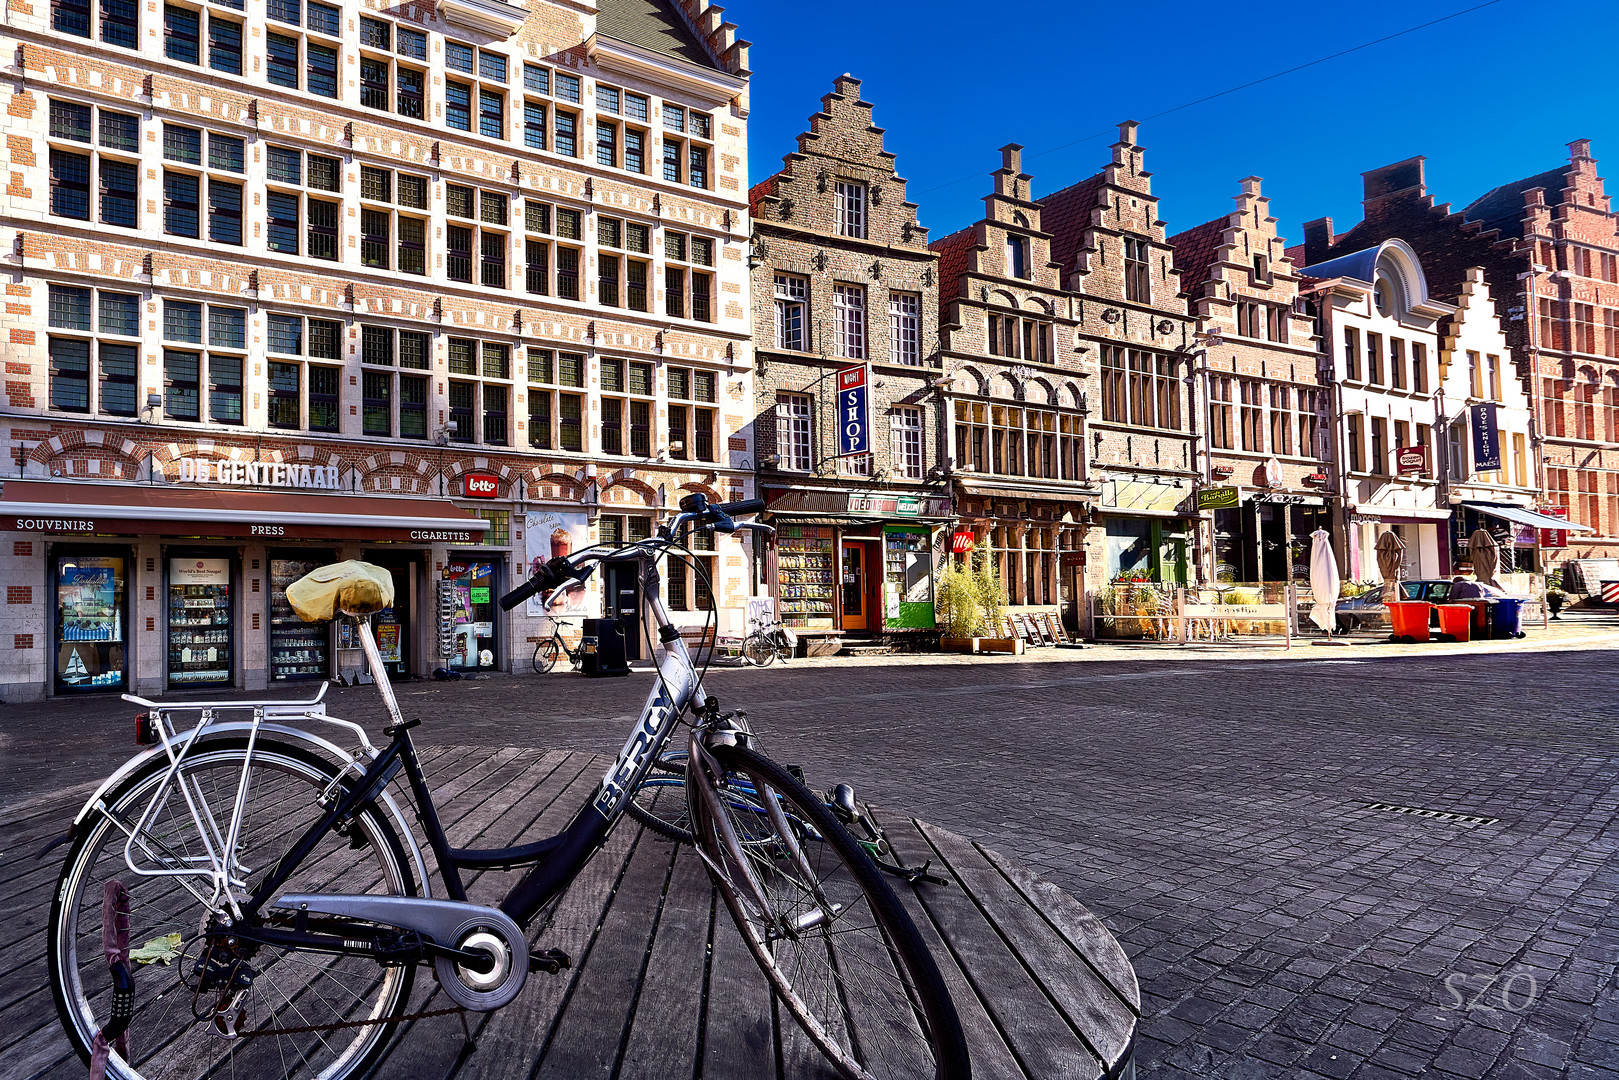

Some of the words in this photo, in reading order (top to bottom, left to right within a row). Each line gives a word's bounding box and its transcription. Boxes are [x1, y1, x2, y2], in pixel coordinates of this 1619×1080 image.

[843, 371, 860, 385] NIGHT
[845, 391, 860, 452] SHOP
[1482, 431, 1490, 457] KNIGHT
[180, 457, 211, 483] DE
[216, 459, 340, 490] GENTENAAR
[16, 519, 94, 532] SOUVENIRS
[250, 525, 285, 536] PRESS
[410, 530, 470, 541] CIGARETTES
